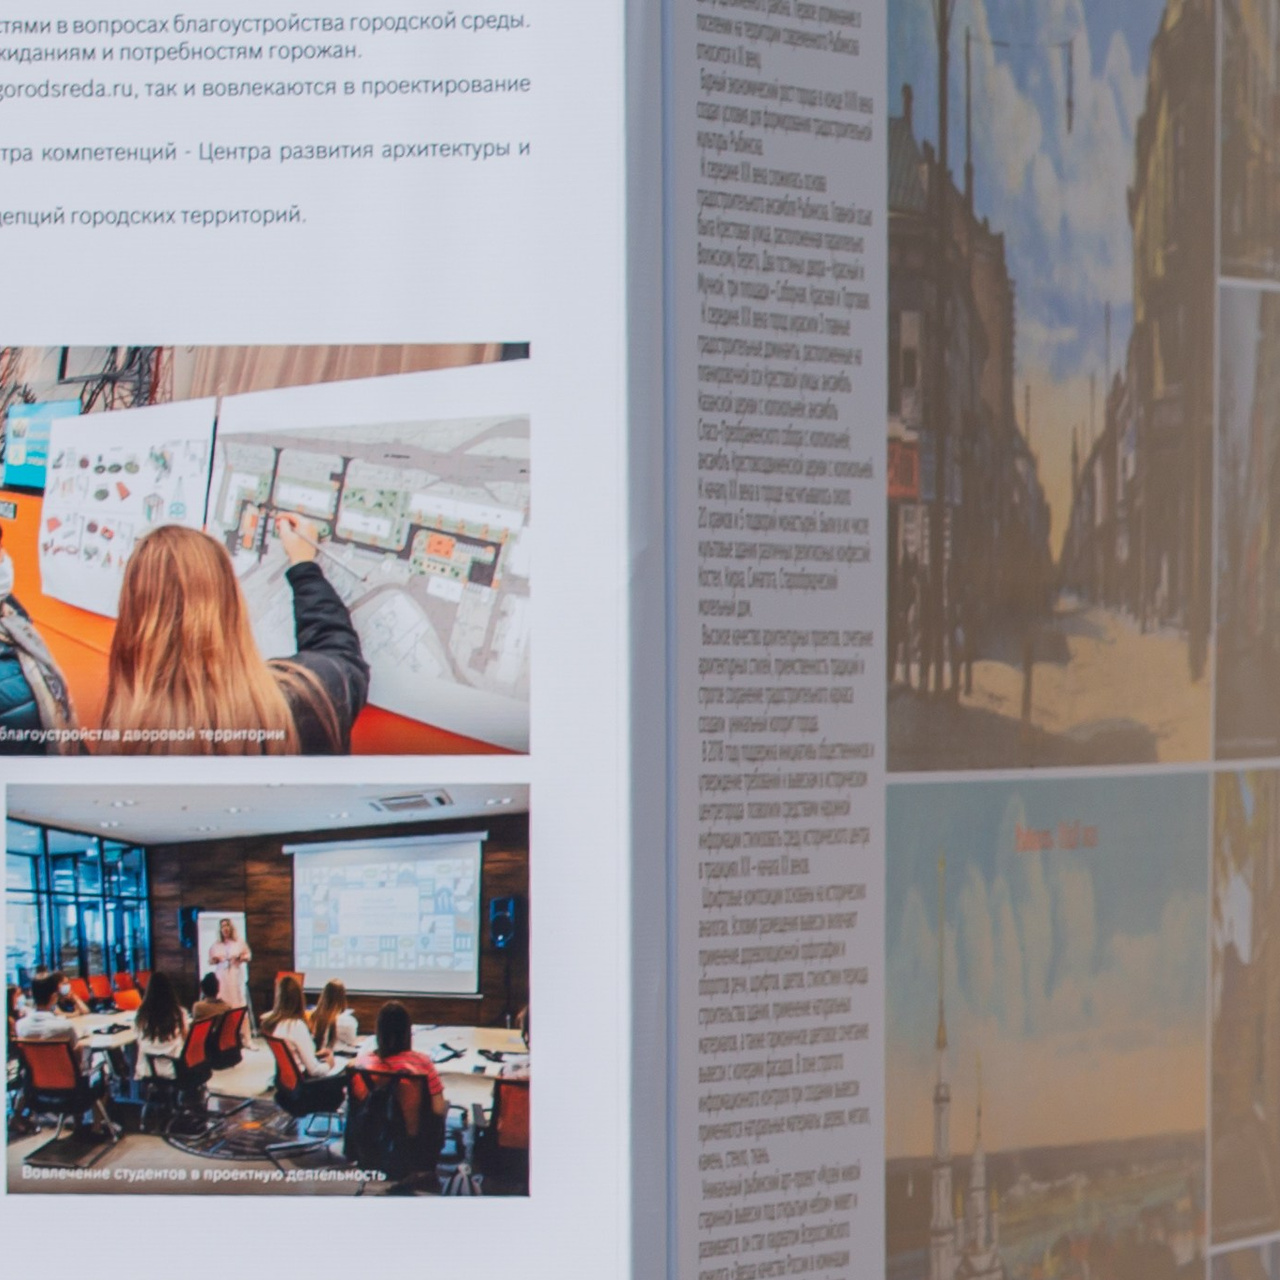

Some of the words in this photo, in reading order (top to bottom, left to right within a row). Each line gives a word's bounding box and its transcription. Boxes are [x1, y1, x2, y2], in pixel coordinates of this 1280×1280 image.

[0, 20, 52, 35] тями
[56, 19, 69, 35] в
[72, 18, 170, 38] вопросах
[172, 12, 345, 37] благоустройства
[349, 10, 457, 35] городской
[460, 14, 531, 33] среды.
[101, 47, 114, 61] и
[119, 40, 263, 65] потребностям
[268, 43, 362, 64] горожан.
[144, 82, 178, 98] так
[183, 82, 196, 97] и
[202, 80, 337, 97] вовлекаются
[343, 80, 356, 96] в
[361, 77, 532, 99] проектирование
[41, 141, 177, 164] компетенций
[198, 141, 272, 164] Центра
[279, 144, 374, 164] развития
[381, 142, 511, 162] архитектуры
[518, 141, 531, 156] и
[0, 206, 66, 229] епций
[70, 210, 176, 229] городских
[180, 204, 307, 228] территорий.
[0, 726, 119, 744] благоустройства
[122, 727, 196, 743] дворовой
[198, 728, 286, 743] территории
[21, 1165, 110, 1181] Вовлечение
[114, 1167, 187, 1182] студентов
[190, 1170, 201, 1181] в
[203, 1168, 284, 1184] проектную
[285, 1168, 387, 1183] деятельность
